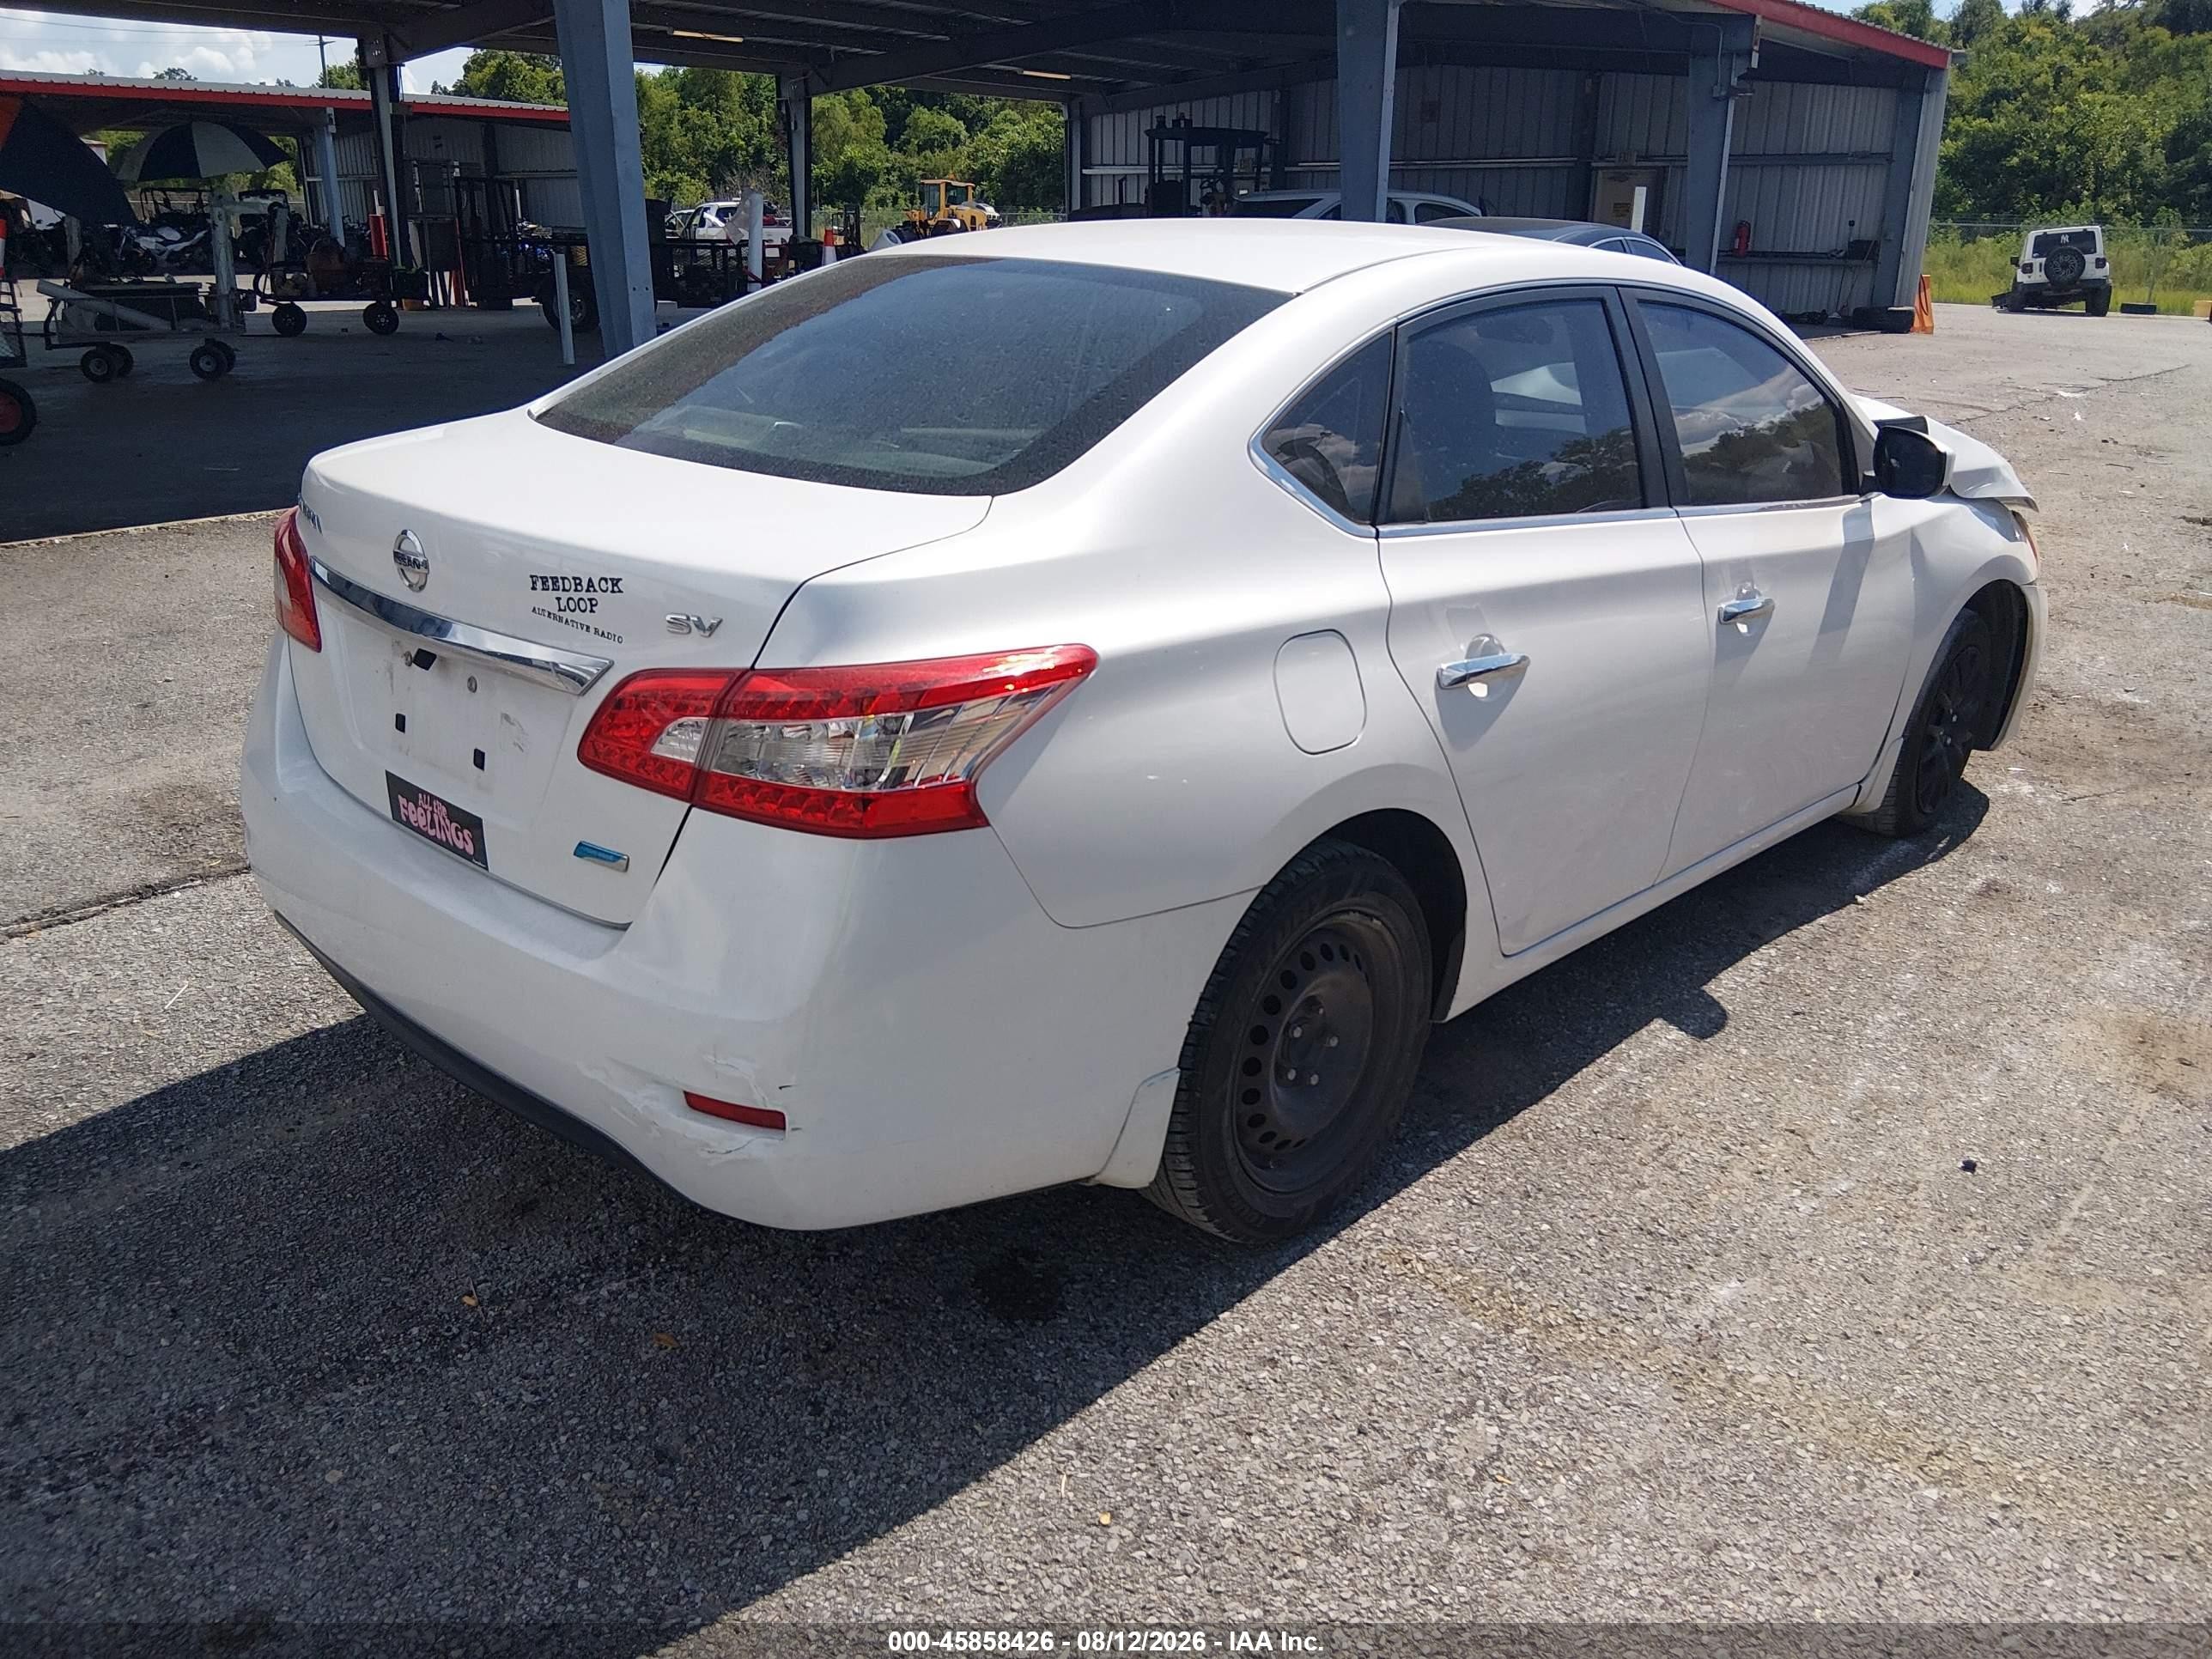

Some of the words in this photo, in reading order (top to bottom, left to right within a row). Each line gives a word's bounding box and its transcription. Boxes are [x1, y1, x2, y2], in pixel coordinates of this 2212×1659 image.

[529, 574, 624, 594] FEEDBACK
[555, 596, 599, 614] LOOP
[532, 605, 592, 633] ALTERNATIVE
[592, 627, 624, 645] RADIO
[665, 612, 723, 638] SV
